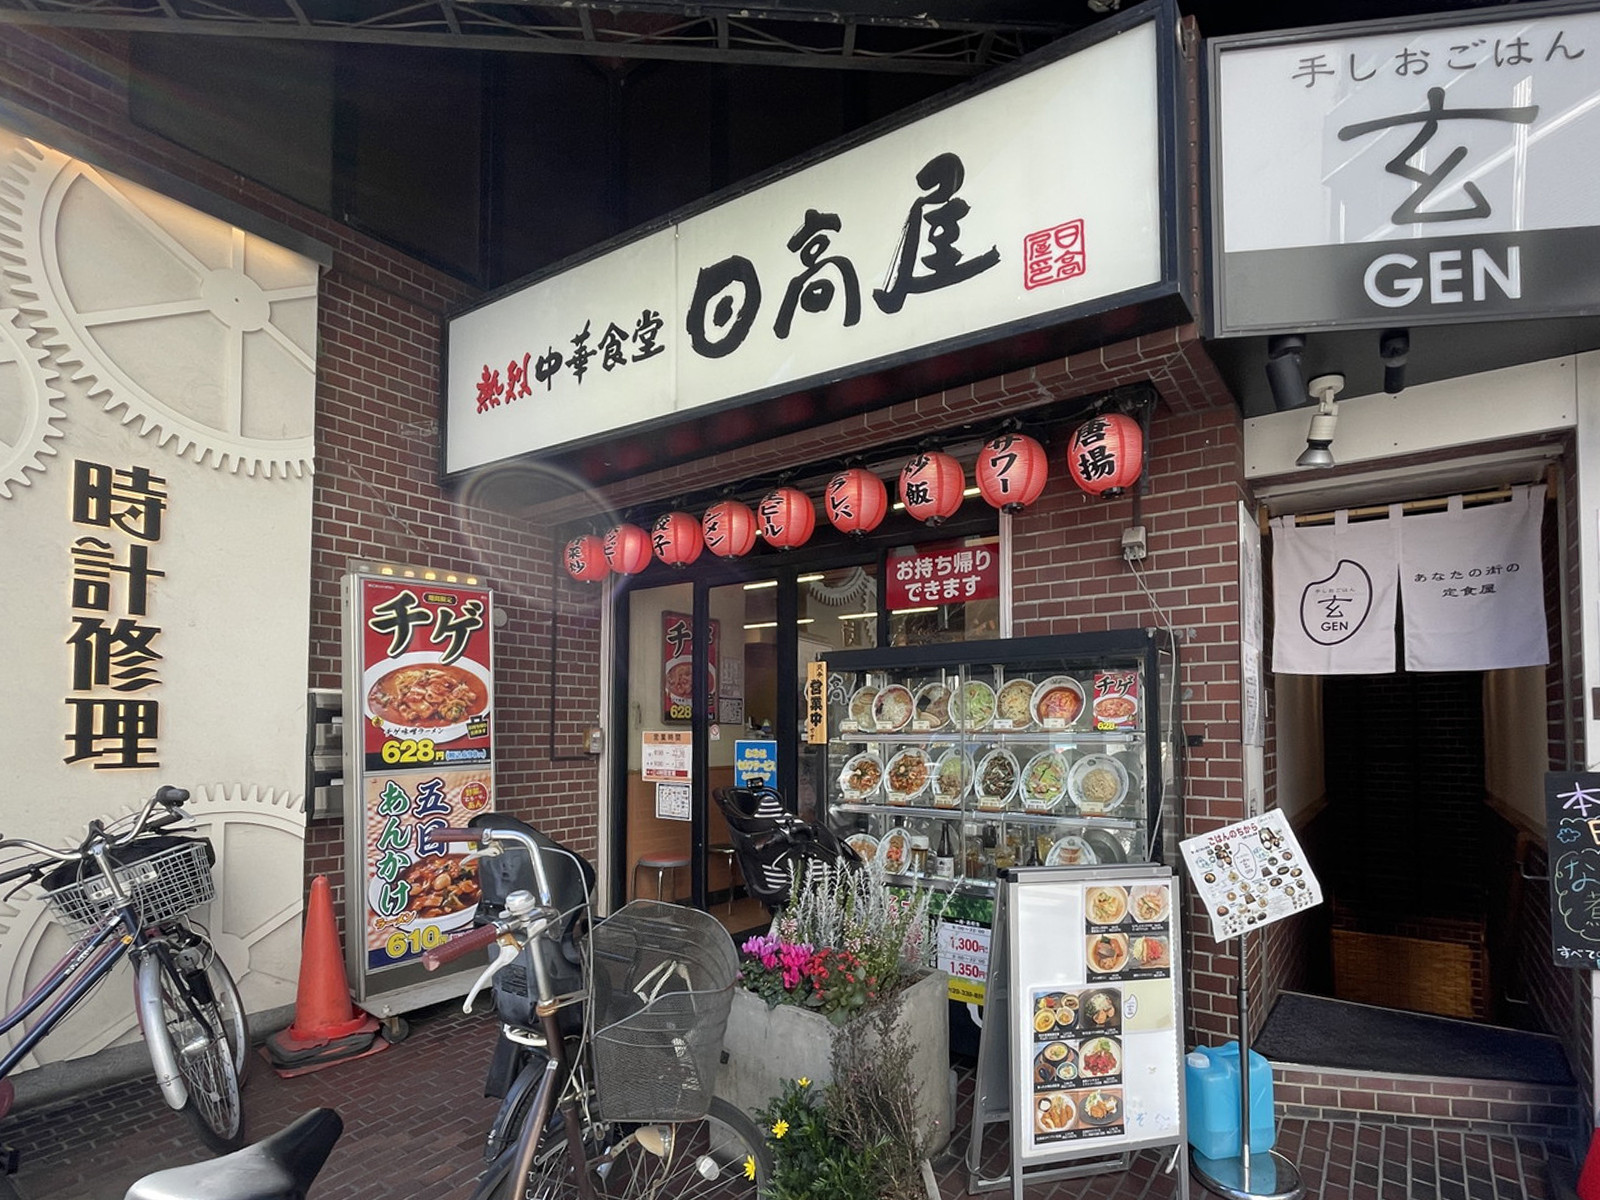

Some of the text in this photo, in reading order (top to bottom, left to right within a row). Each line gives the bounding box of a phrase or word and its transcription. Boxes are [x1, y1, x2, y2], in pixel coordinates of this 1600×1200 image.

[1292, 31, 1585, 88] 手しおごはん
[1337, 86, 1540, 226] 玄
[687, 152, 1001, 359] 日高屋
[1363, 246, 1522, 308] GEN
[987, 435, 1022, 493] サワー
[1073, 417, 1116, 481] 唐揚
[903, 454, 934, 506] 炒飯
[704, 507, 724, 547] ンメン
[896, 549, 991, 580] お持ち帰り
[904, 574, 981, 602] できます
[1414, 562, 1520, 582] あなたの街の
[1442, 583, 1497, 598] 定食屋
[63, 459, 168, 770] 時計修理
[368, 588, 484, 666] チゲ
[1317, 594, 1353, 618] 玄
[1321, 621, 1349, 631] GEN
[810, 679, 823, 728] 営業中
[1095, 674, 1135, 697] チゲ
[413, 777, 451, 857] 五目
[377, 779, 411, 916] あんかけ
